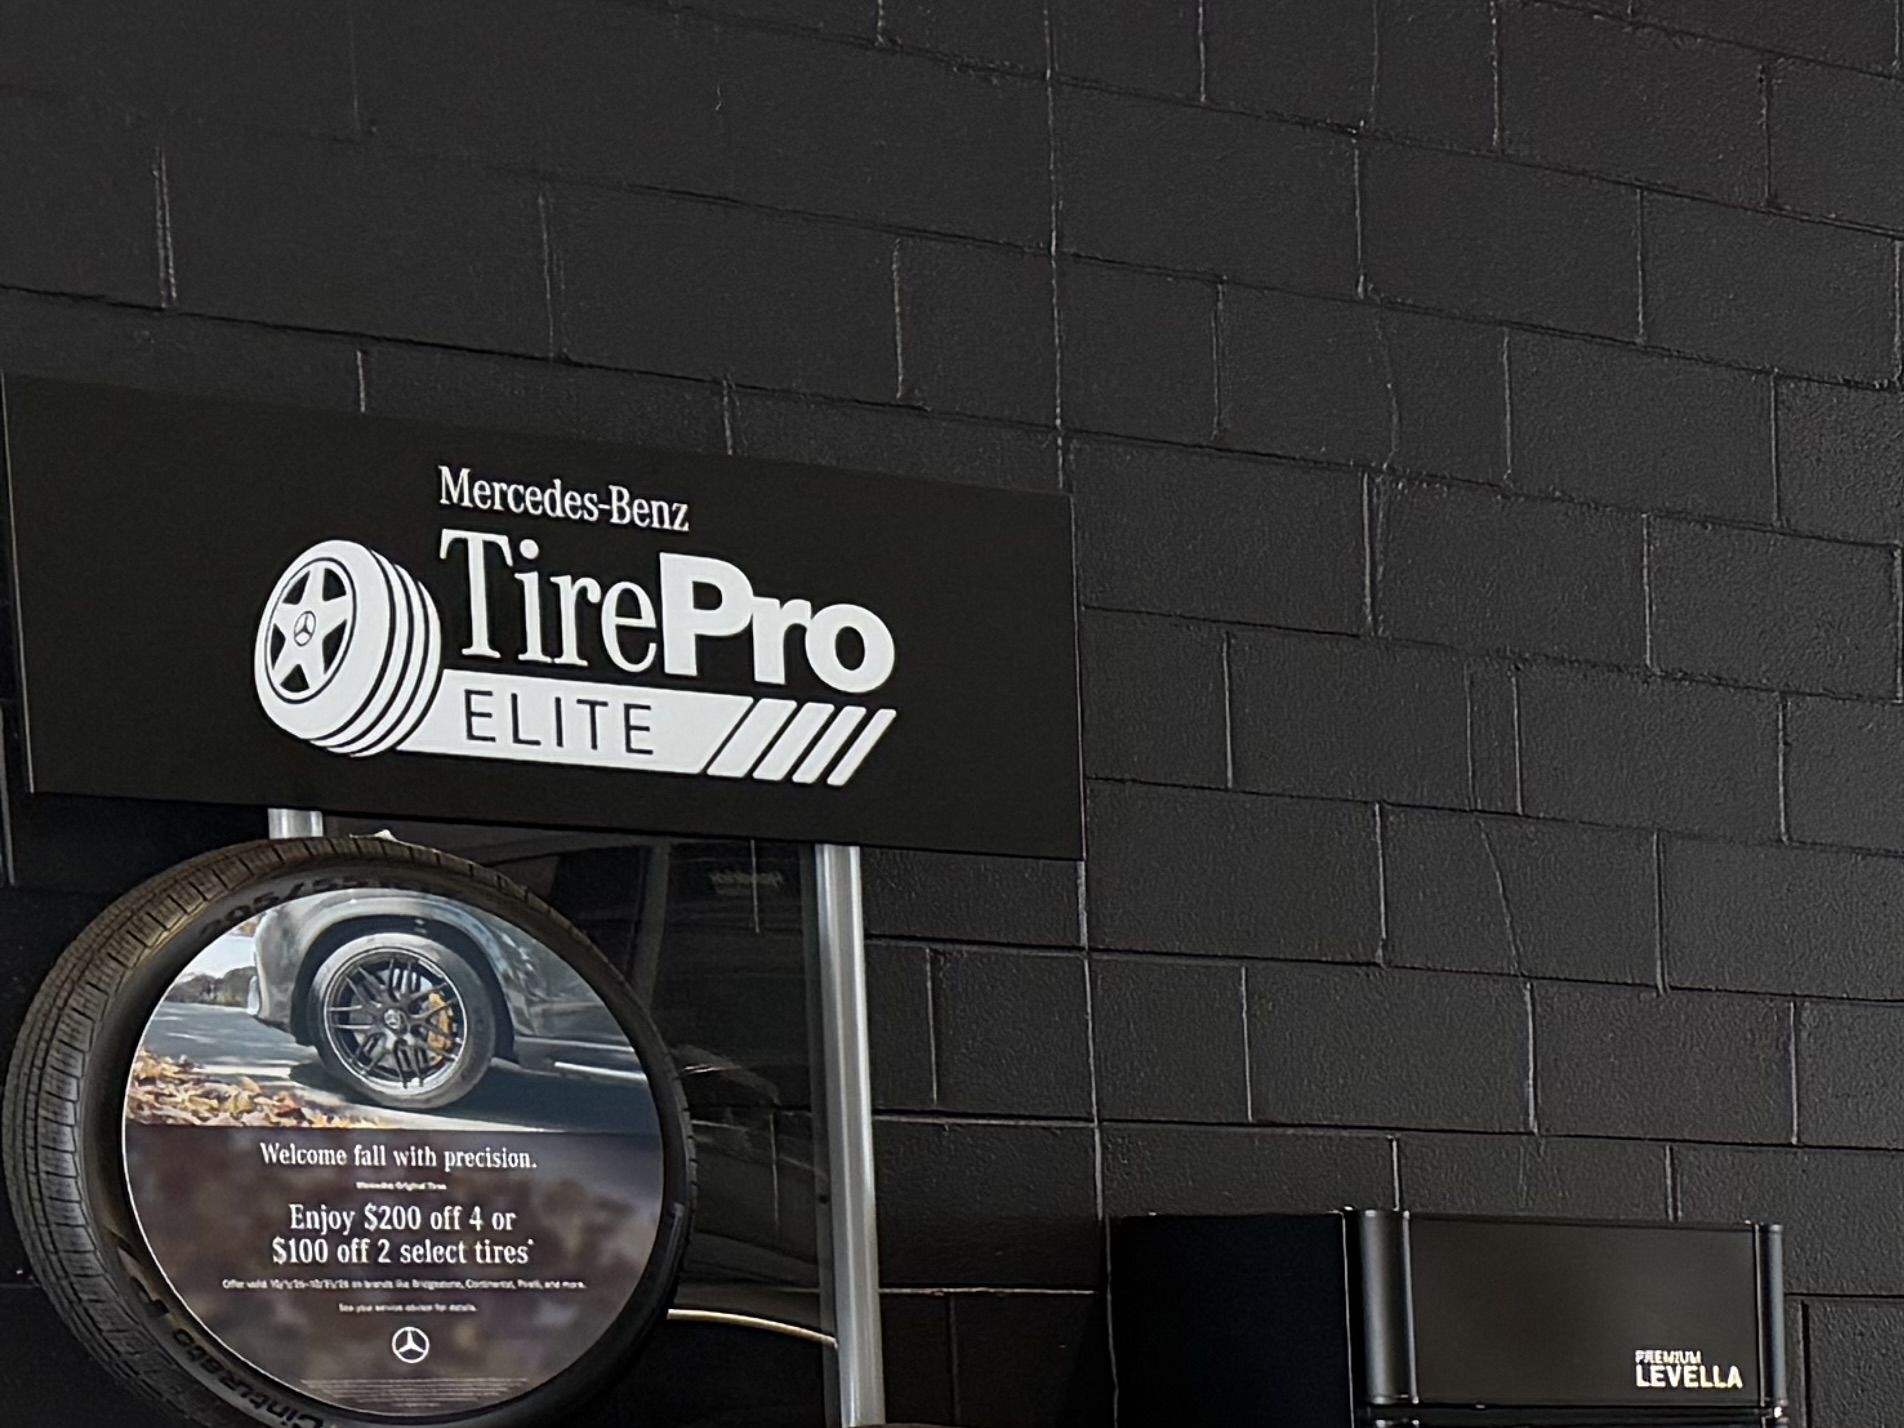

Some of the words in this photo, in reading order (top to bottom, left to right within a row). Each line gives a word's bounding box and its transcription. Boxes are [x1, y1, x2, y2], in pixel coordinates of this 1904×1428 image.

[438, 465, 690, 532] Mercedes-Benz
[466, 689, 654, 756] ELITE
[260, 1142, 347, 1166] Welcome
[354, 1144, 386, 1167] fall
[392, 1146, 437, 1168] with
[444, 1147, 538, 1172] precision.
[289, 1203, 355, 1235] Enjoy
[363, 1202, 421, 1232] $200
[430, 1205, 463, 1230] off
[468, 1205, 485, 1231] 4
[491, 1213, 517, 1231] or
[272, 1236, 328, 1265] $100
[337, 1238, 371, 1264] off
[376, 1239, 393, 1264] 2
[399, 1239, 468, 1265] select
[1635, 1349, 1702, 1364] PREMIUM
[1635, 1364, 1743, 1389] LEVELLA
